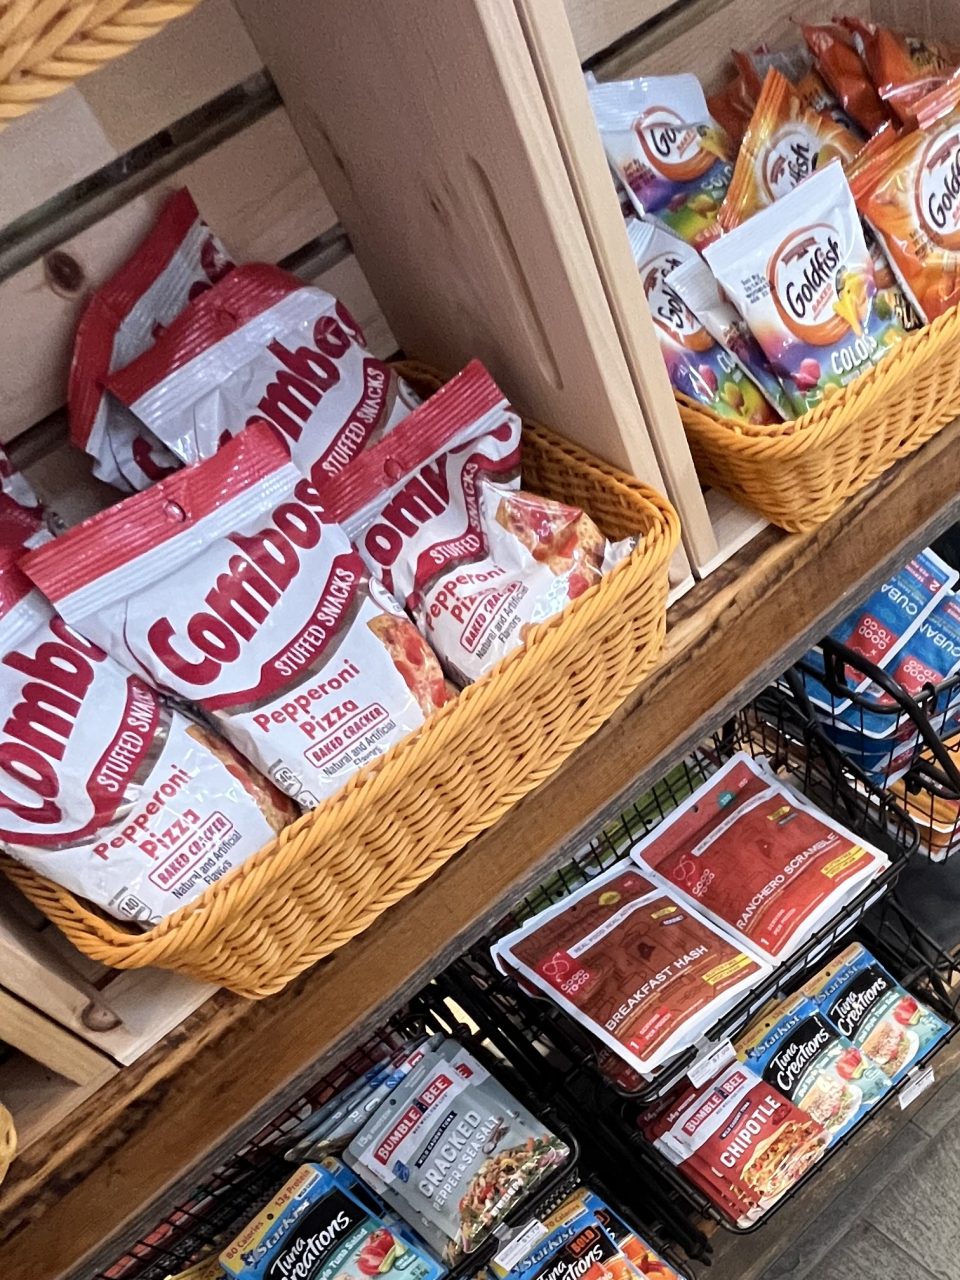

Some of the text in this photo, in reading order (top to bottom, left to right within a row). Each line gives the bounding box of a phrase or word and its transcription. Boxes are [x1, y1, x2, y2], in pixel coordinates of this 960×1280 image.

[786, 237, 840, 319] Goldfish
[321, 367, 386, 478] STUFFED SNACKS
[429, 463, 482, 564] STUFFED SNACKS
[147, 478, 325, 685] Combos
[881, 582, 918, 616] CUBA
[273, 567, 356, 677] STUFFED SNACKS
[475, 628, 495, 660] Natural
[253, 658, 361, 733] Pepperoni
[300, 699, 359, 740] Pizza
[98, 730, 144, 793] STUFFED
[311, 706, 386, 762] BAKED CRACKER
[322, 718, 397, 778] Natural and Artificial
[92, 763, 194, 861] Pepperoni
[139, 808, 201, 861] Pizza
[157, 851, 191, 884] BAKED
[171, 830, 244, 900] Natural and Artificial
[692, 867, 710, 895] GOOD
[736, 875, 785, 931] RANCHERO
[783, 831, 839, 875] SCRAMBLE
[561, 969, 586, 991] GOOD
[605, 944, 709, 1032] BREAKFAST HASH
[831, 991, 859, 1019] Tuna
[837, 977, 887, 1037] Creations
[769, 1042, 799, 1072] Tuna
[777, 1027, 830, 1091] Creations
[377, 1077, 449, 1162] BUMBLE BEE
[441, 1113, 454, 1130] TUNA
[685, 1093, 722, 1134] BUMBLE
[722, 1073, 744, 1095] BEE
[719, 1094, 782, 1168] CHIPOTLE
[418, 1109, 482, 1199] CRACKED
[432, 1169, 463, 1211] PEPPER
[462, 1140, 481, 1166] SEA
[476, 1115, 499, 1142] SALT
[225, 1246, 239, 1260] 80
[237, 1221, 264, 1248] Calories
[286, 1169, 311, 1196] Protein
[570, 1228, 595, 1254] BOLD
[270, 1237, 307, 1276] Tuna
[330, 1248, 349, 1269] Tuna
[345, 1227, 369, 1251] Salad
[520, 1226, 576, 1268] StarKist
